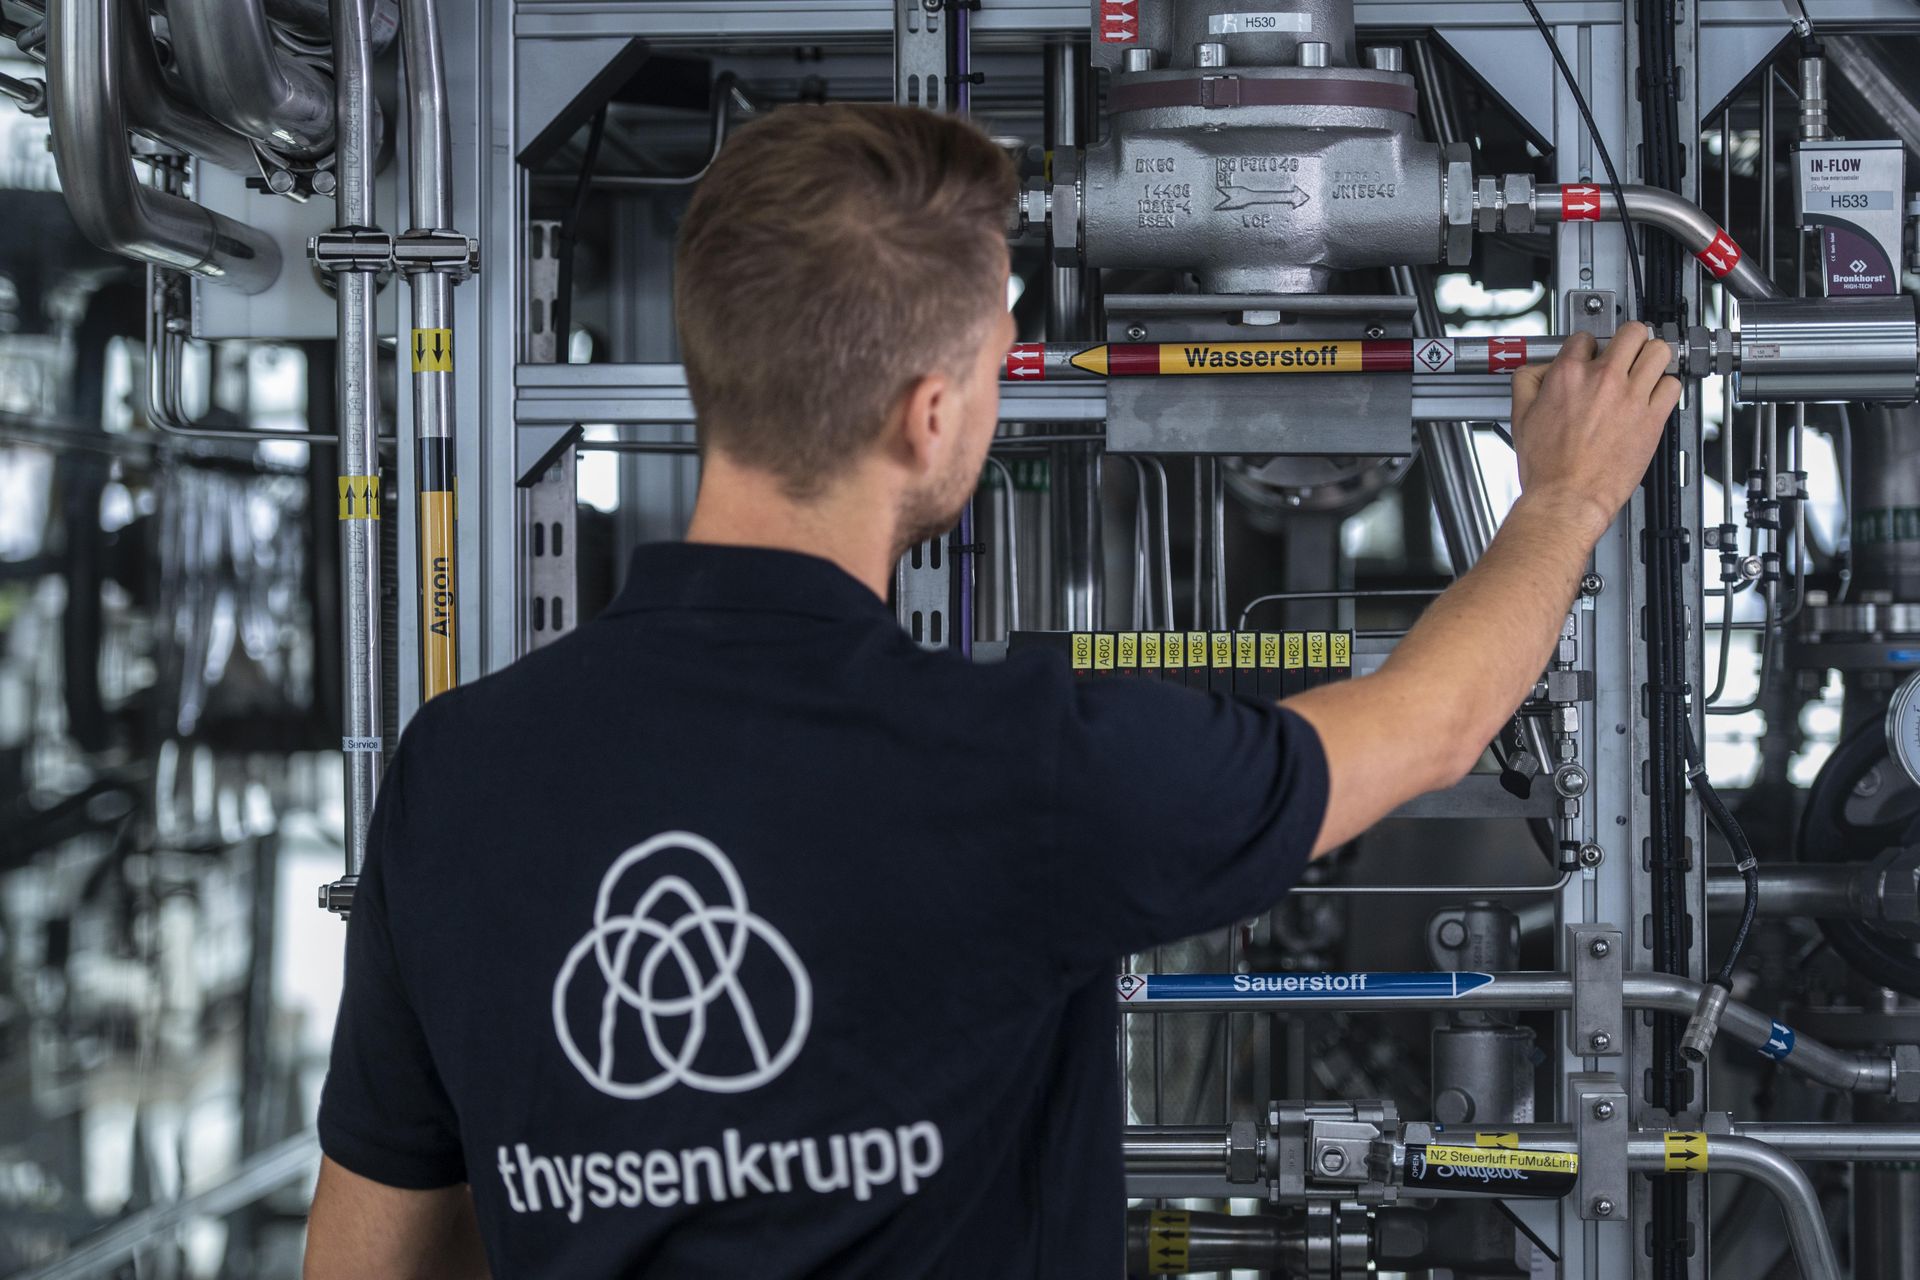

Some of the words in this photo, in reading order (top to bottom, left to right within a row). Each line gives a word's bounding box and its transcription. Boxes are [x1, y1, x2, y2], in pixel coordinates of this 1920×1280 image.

[1245, 17, 1276, 28] H530
[1811, 158, 1861, 172] IN-FLOW
[1831, 194, 1869, 208] H533
[1833, 274, 1884, 282] Bronkhorst
[1184, 346, 1338, 367] Wasserstoff
[430, 557, 454, 638] Argon
[1077, 636, 1088, 665] H602
[1100, 638, 1110, 666] A602
[1122, 636, 1133, 664] H827
[1146, 636, 1157, 664] H927
[1169, 636, 1180, 664] H892
[1193, 634, 1203, 663] H055
[1217, 635, 1228, 665] H056
[1241, 635, 1251, 664] H424
[1265, 636, 1275, 664] H524
[1289, 636, 1299, 665] H623
[1312, 634, 1322, 663] H423
[1335, 634, 1346, 664] H523
[348, 740, 378, 749] Service
[1233, 974, 1367, 992] Sauerstoff
[498, 1120, 944, 1223] thyssenkrupp
[1412, 1154, 1420, 1177] OPEN
[1430, 1149, 1447, 1161] N2
[1450, 1150, 1506, 1164] Steuerluft
[1510, 1154, 1576, 1169] FuMu&Line
